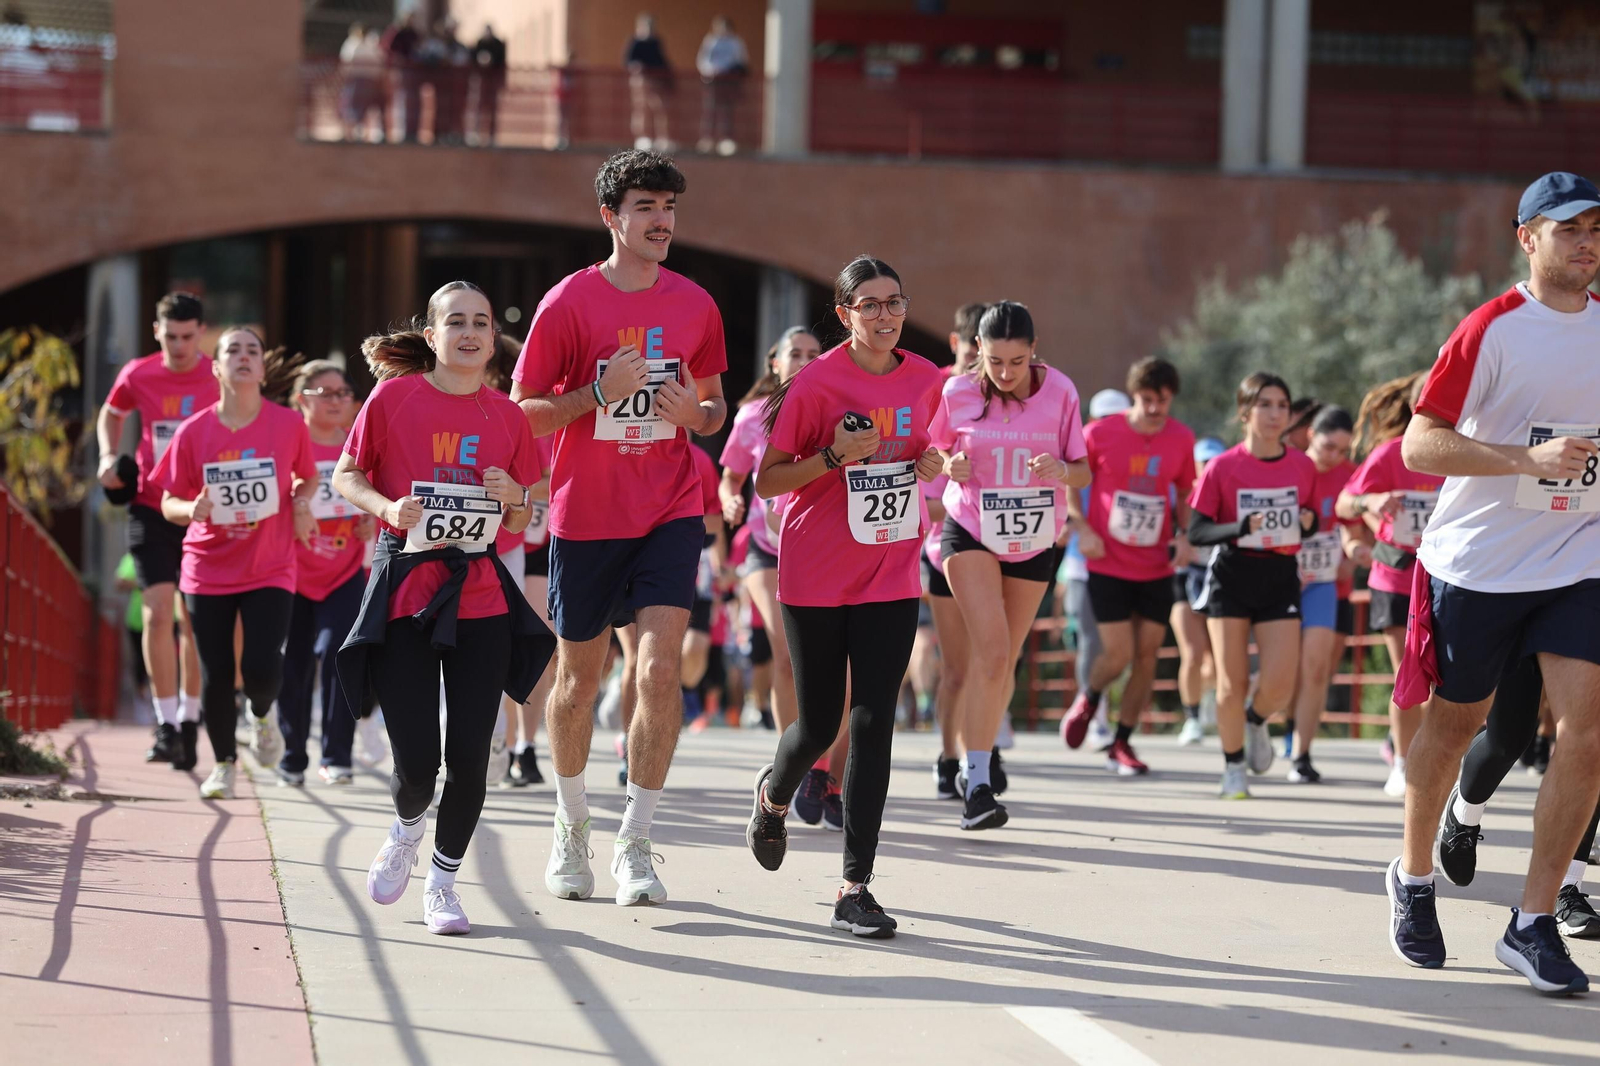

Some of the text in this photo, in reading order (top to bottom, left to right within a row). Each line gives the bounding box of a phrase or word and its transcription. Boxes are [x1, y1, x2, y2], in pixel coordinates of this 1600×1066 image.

[617, 327, 663, 358] WE
[163, 394, 195, 417] WE
[613, 389, 662, 418] 20
[870, 406, 911, 437] WE
[1004, 431, 1018, 440] POR
[1021, 432, 1029, 440] EL
[433, 432, 479, 465] WE
[207, 471, 239, 482] UMA
[991, 446, 1031, 486] 10
[219, 482, 267, 507] 360
[851, 478, 888, 490] UMA
[863, 490, 911, 523] 287
[985, 499, 1018, 510] UMA
[425, 513, 487, 542] 684
[995, 511, 1044, 536] 157
[1120, 512, 1157, 532] 374
[1259, 509, 1292, 531] 80
